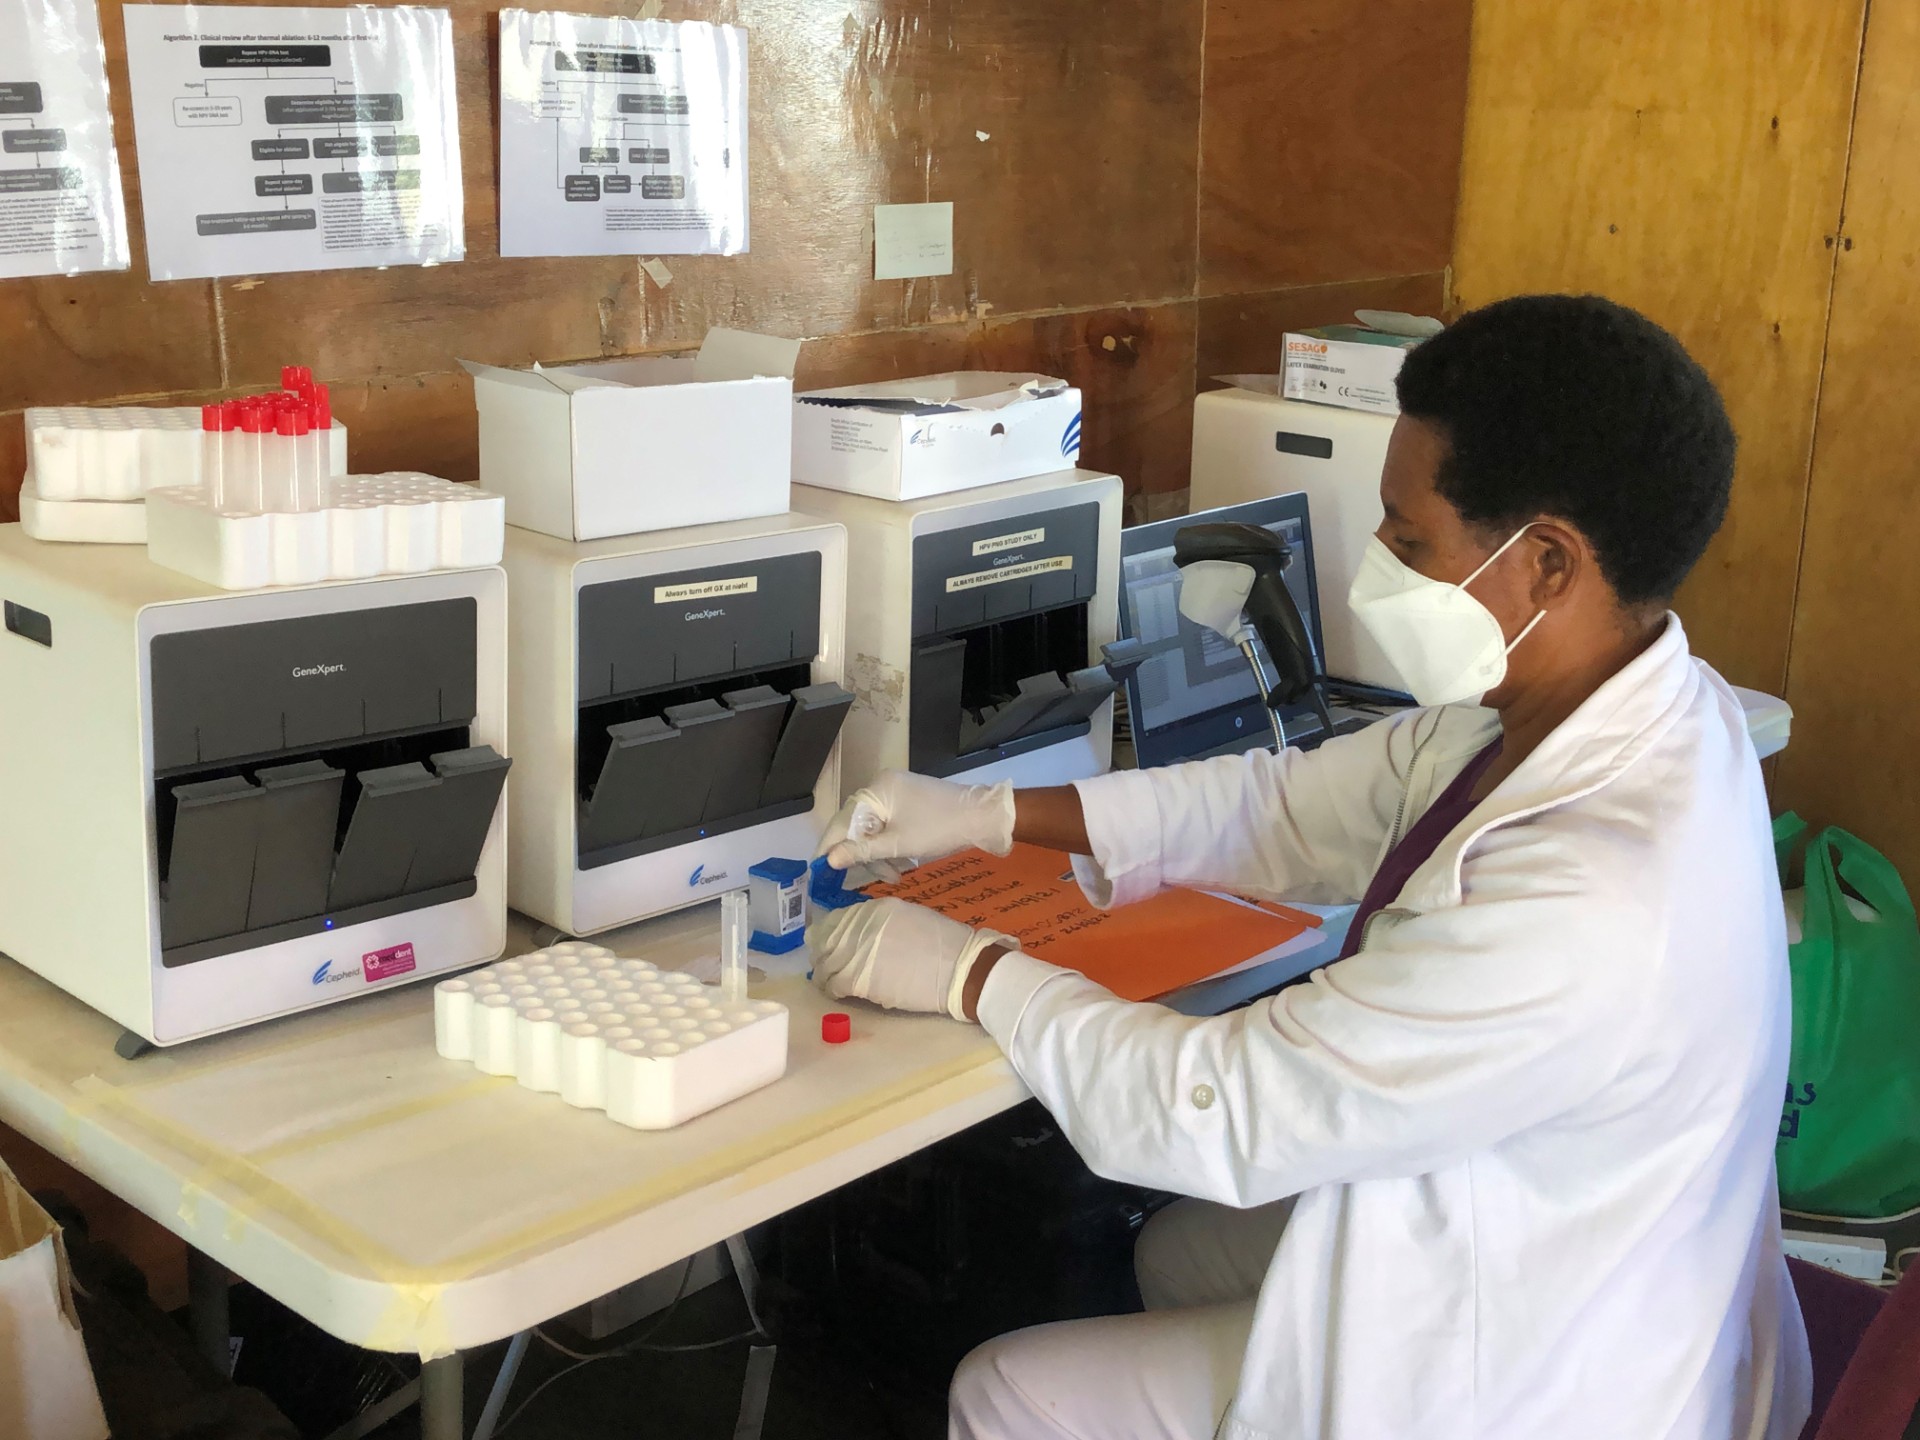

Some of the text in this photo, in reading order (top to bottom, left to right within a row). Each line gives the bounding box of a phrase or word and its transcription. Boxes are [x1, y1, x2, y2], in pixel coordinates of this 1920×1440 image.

[1004, 537, 1022, 545] STUDY
[1023, 533, 1037, 541] ONLY
[993, 553, 1022, 566] GeneXpert
[953, 577, 974, 587] ALWAYS
[976, 572, 998, 582] REMOVE
[1000, 566, 1032, 578] CARTRIDGES
[1033, 562, 1050, 571] AFTER
[684, 609, 724, 621] GeneXpert
[292, 664, 344, 678] GeneXpert
[325, 968, 360, 983] Cepheid
